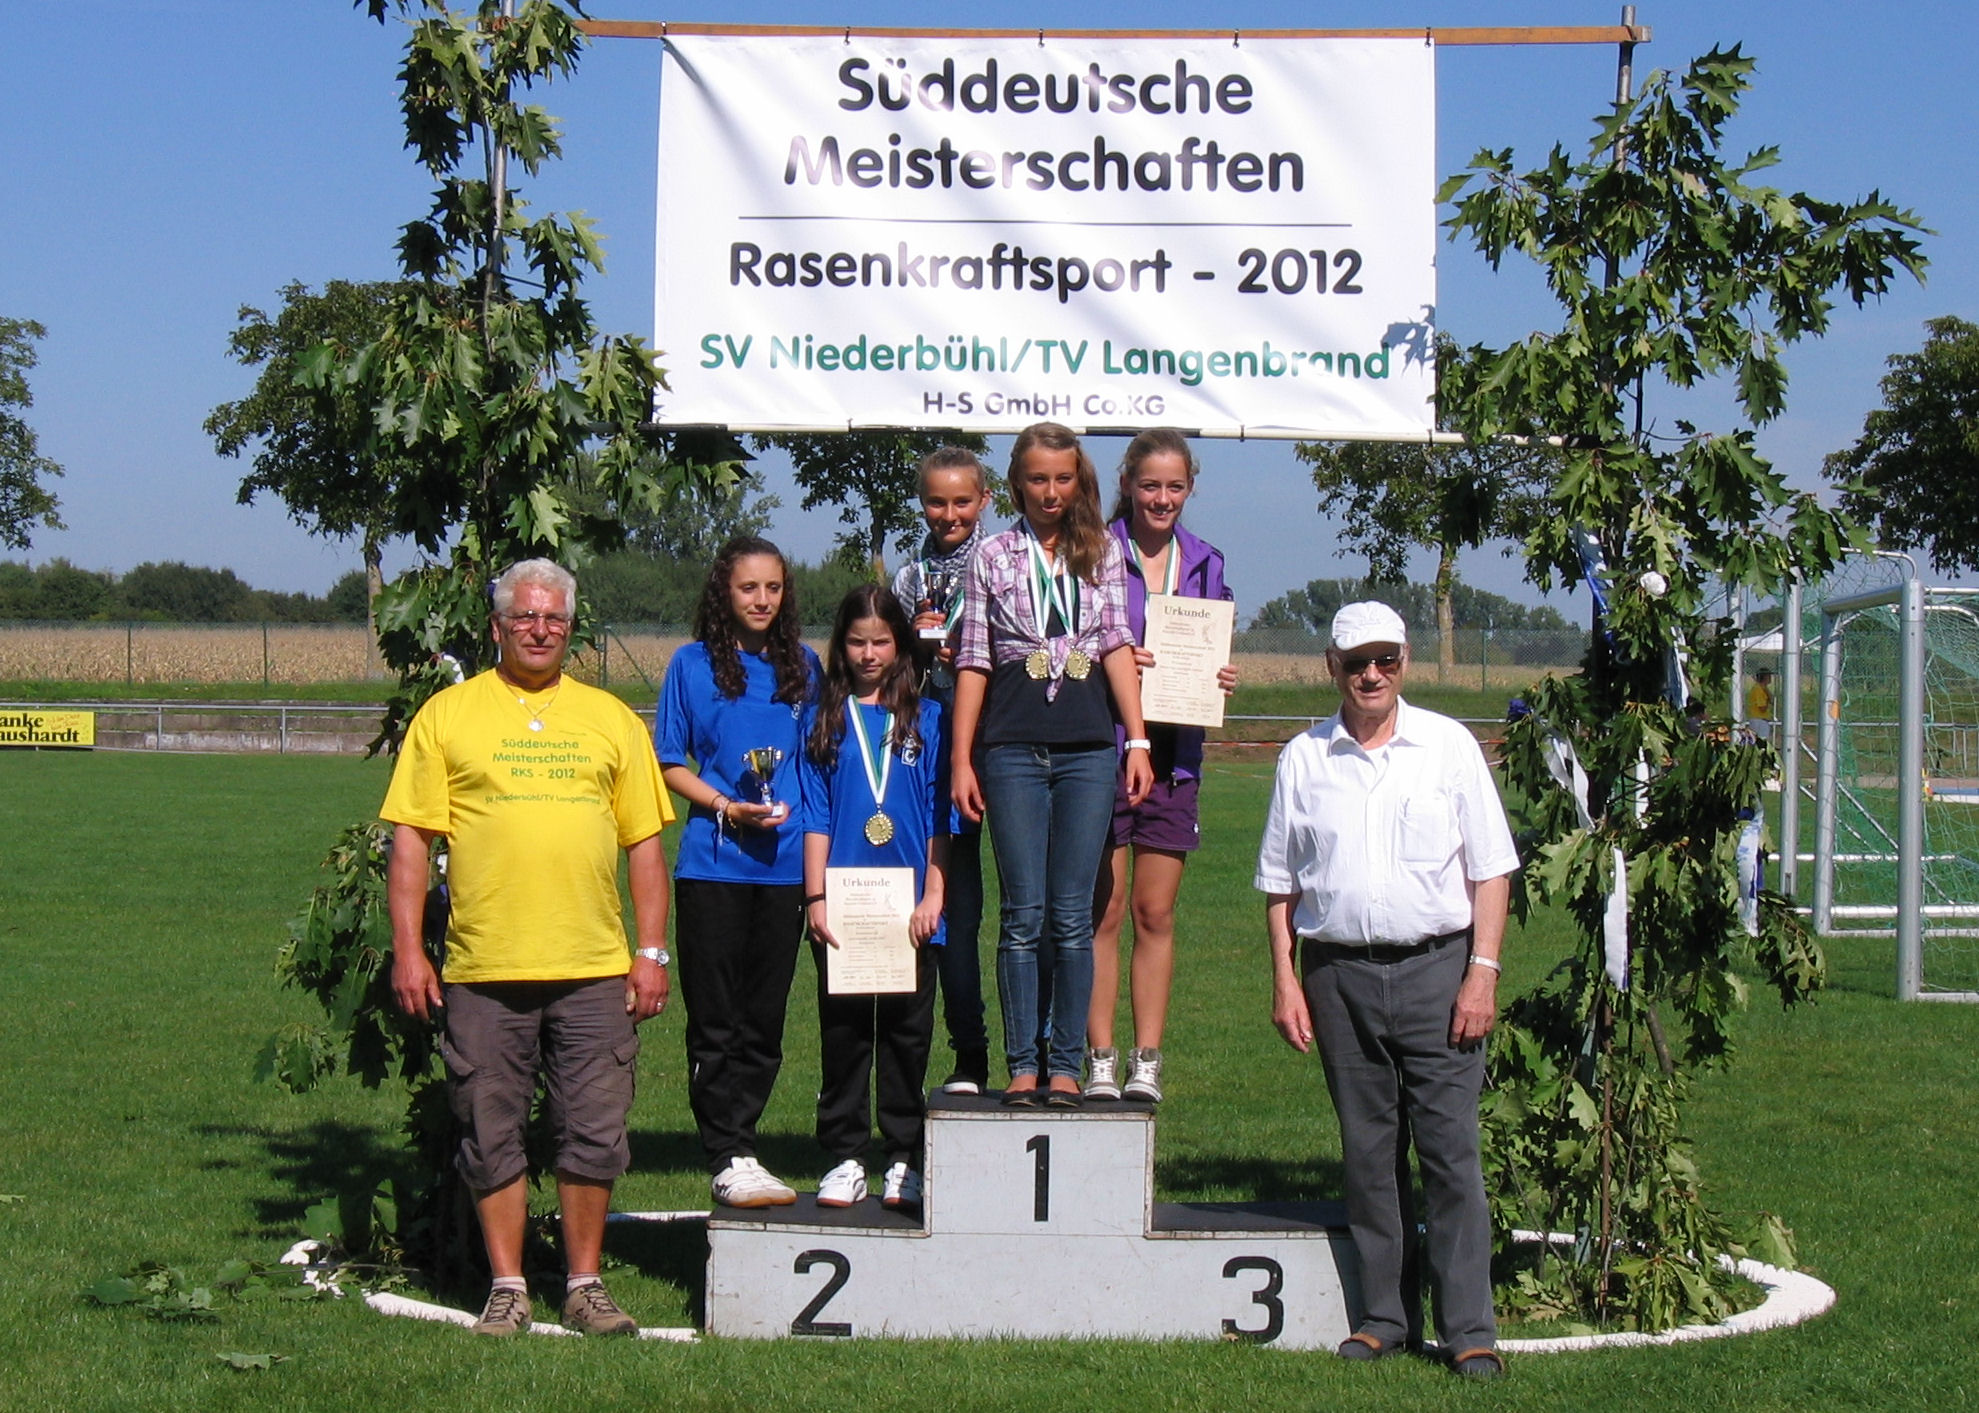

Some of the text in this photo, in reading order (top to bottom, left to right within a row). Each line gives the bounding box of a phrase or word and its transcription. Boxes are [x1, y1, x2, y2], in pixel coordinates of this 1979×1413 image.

[838, 56, 1254, 115] Süddeutsche
[783, 133, 1304, 193] Meisterschaften
[728, 241, 1364, 303] Rasenkraftsport - 2012
[699, 333, 1390, 387] SV Niederbühl/TV Langenbrand
[922, 391, 974, 415] H-S
[984, 391, 1072, 416] GmbH
[1164, 605, 1211, 619] Urkunde
[492, 752, 591, 764] Meisterschaften
[501, 738, 579, 749] Süddeutsche
[510, 767, 534, 779] RKS
[548, 768, 576, 779] 2012
[842, 877, 891, 888] Urkunde
[1025, 1134, 1051, 1223] 1
[791, 1249, 853, 1338] 2
[1220, 1255, 1284, 1345] 3
